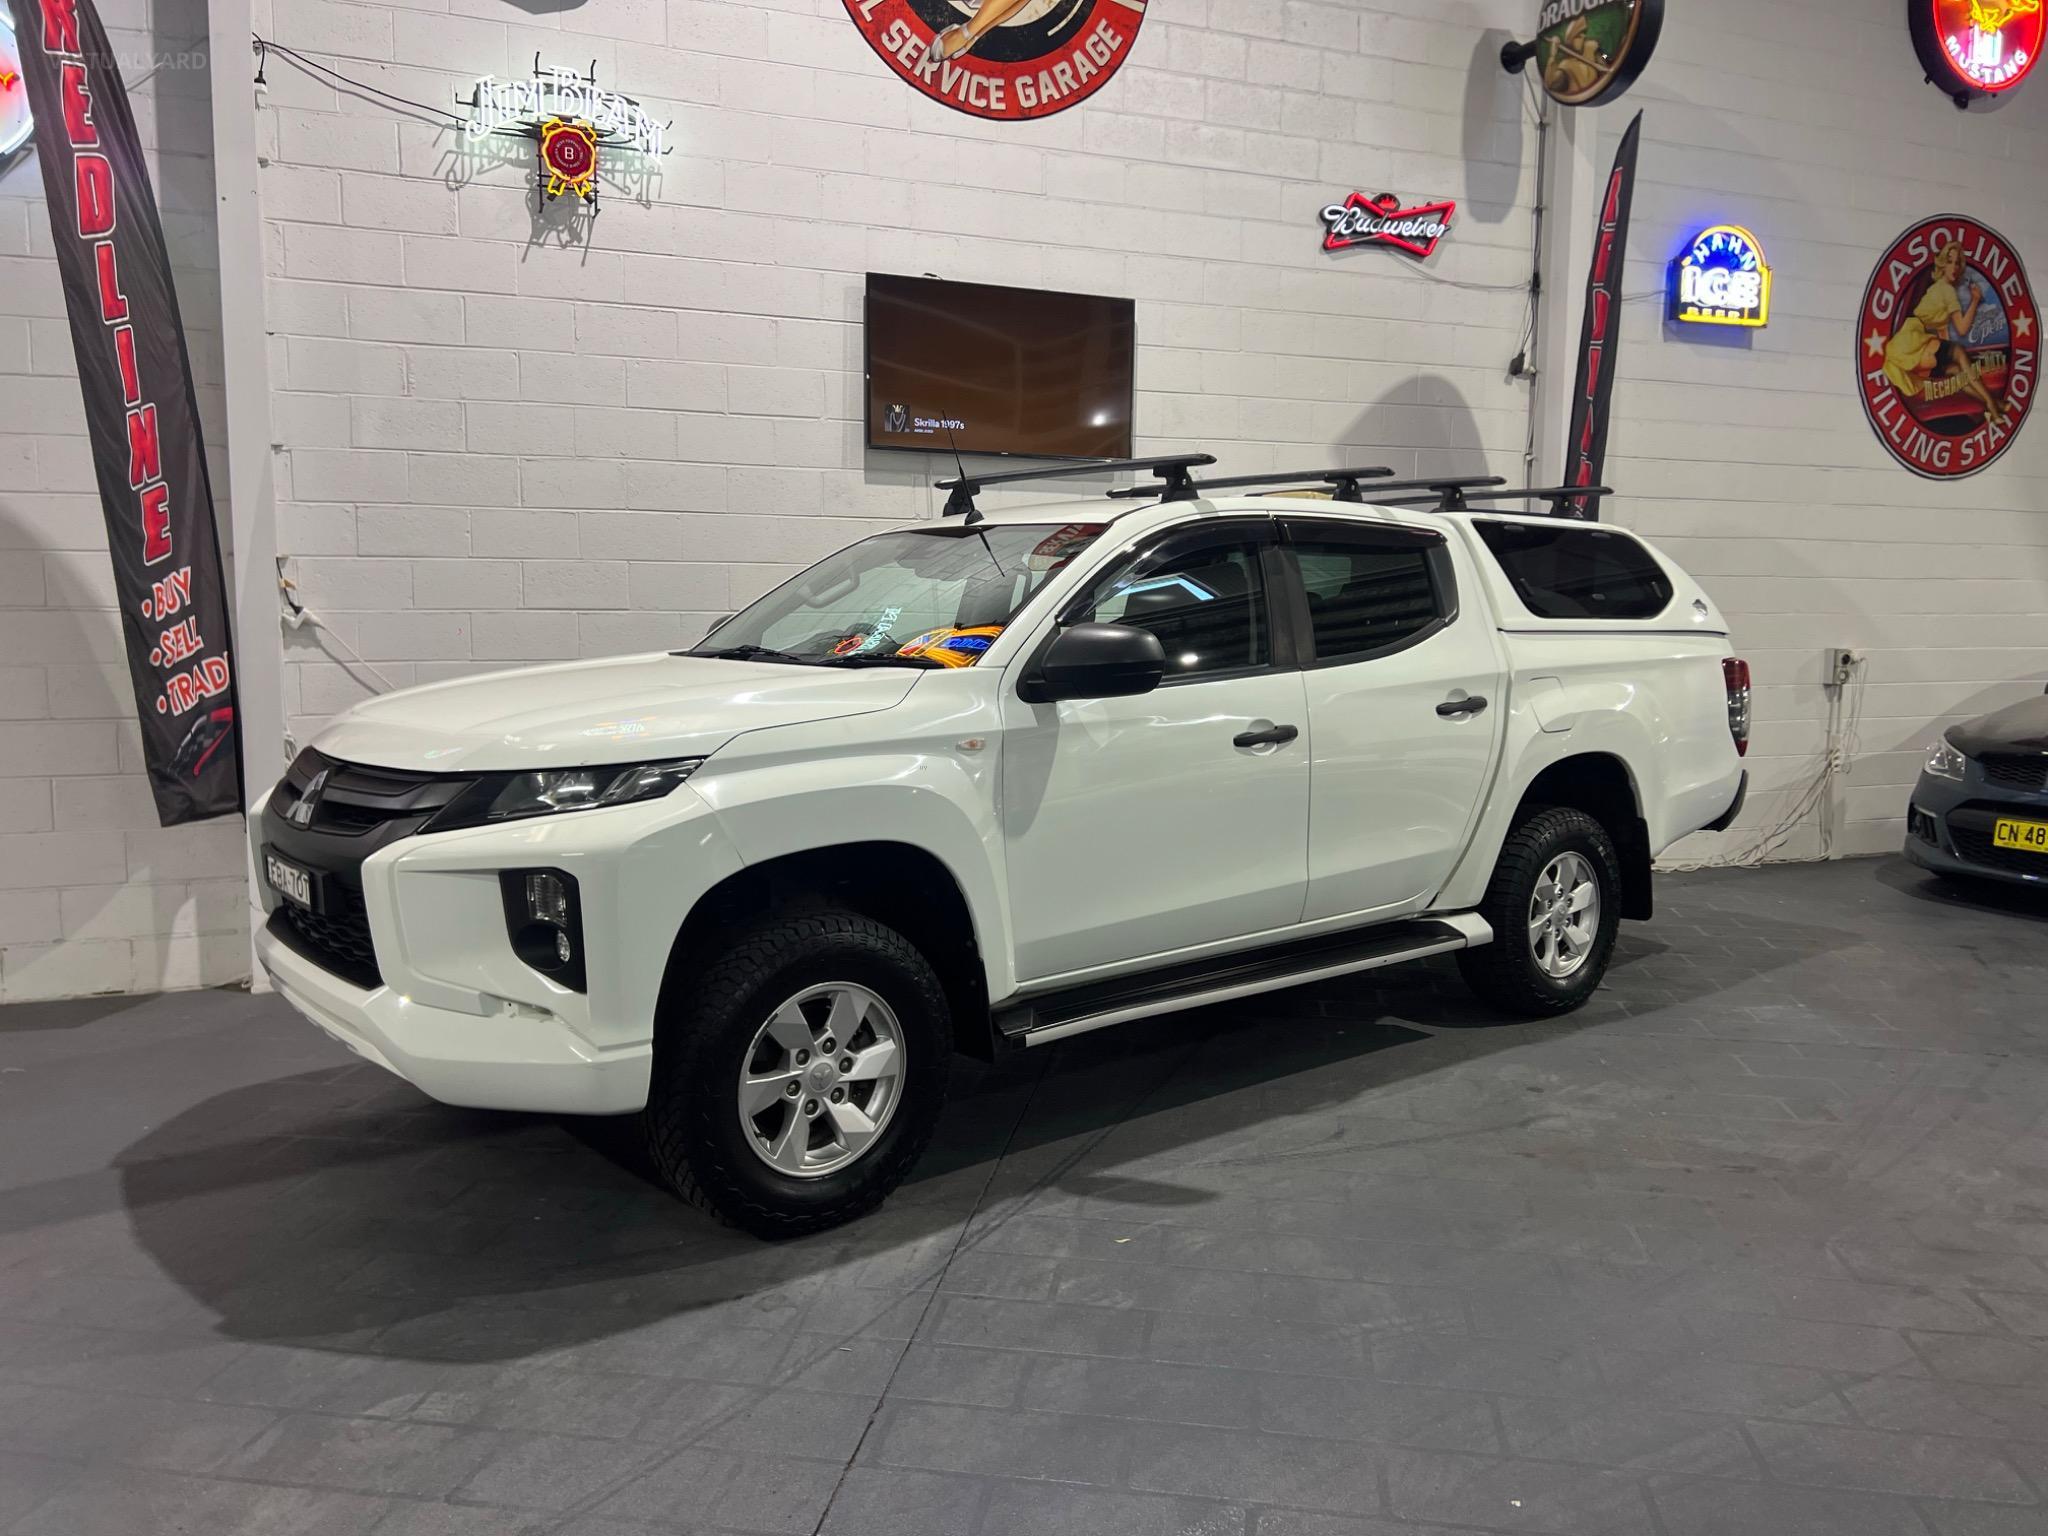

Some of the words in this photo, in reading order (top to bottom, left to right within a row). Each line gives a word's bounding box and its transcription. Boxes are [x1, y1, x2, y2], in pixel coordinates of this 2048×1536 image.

[1537, 0, 1615, 33] DRAU
[881, 19, 1007, 110] SERVICE
[1014, 18, 1123, 109] GARAGE
[1945, 35, 2028, 83] MUSTANG
[564, 146, 574, 160] B
[1323, 205, 1448, 238] Budweiser
[1693, 233, 1757, 271] HAHN
[1872, 227, 2023, 320] GASOLINE
[40, 0, 172, 566] REDLINE
[914, 418, 940, 428] Skrilla
[1867, 369, 1952, 467] FILLING
[1960, 349, 2033, 466] STATION
[152, 566, 191, 622] BUY
[160, 615, 204, 669] SELL
[166, 652, 230, 717] TRAD
[1998, 823, 2020, 842] CN
[2024, 826, 2046, 846] 48
